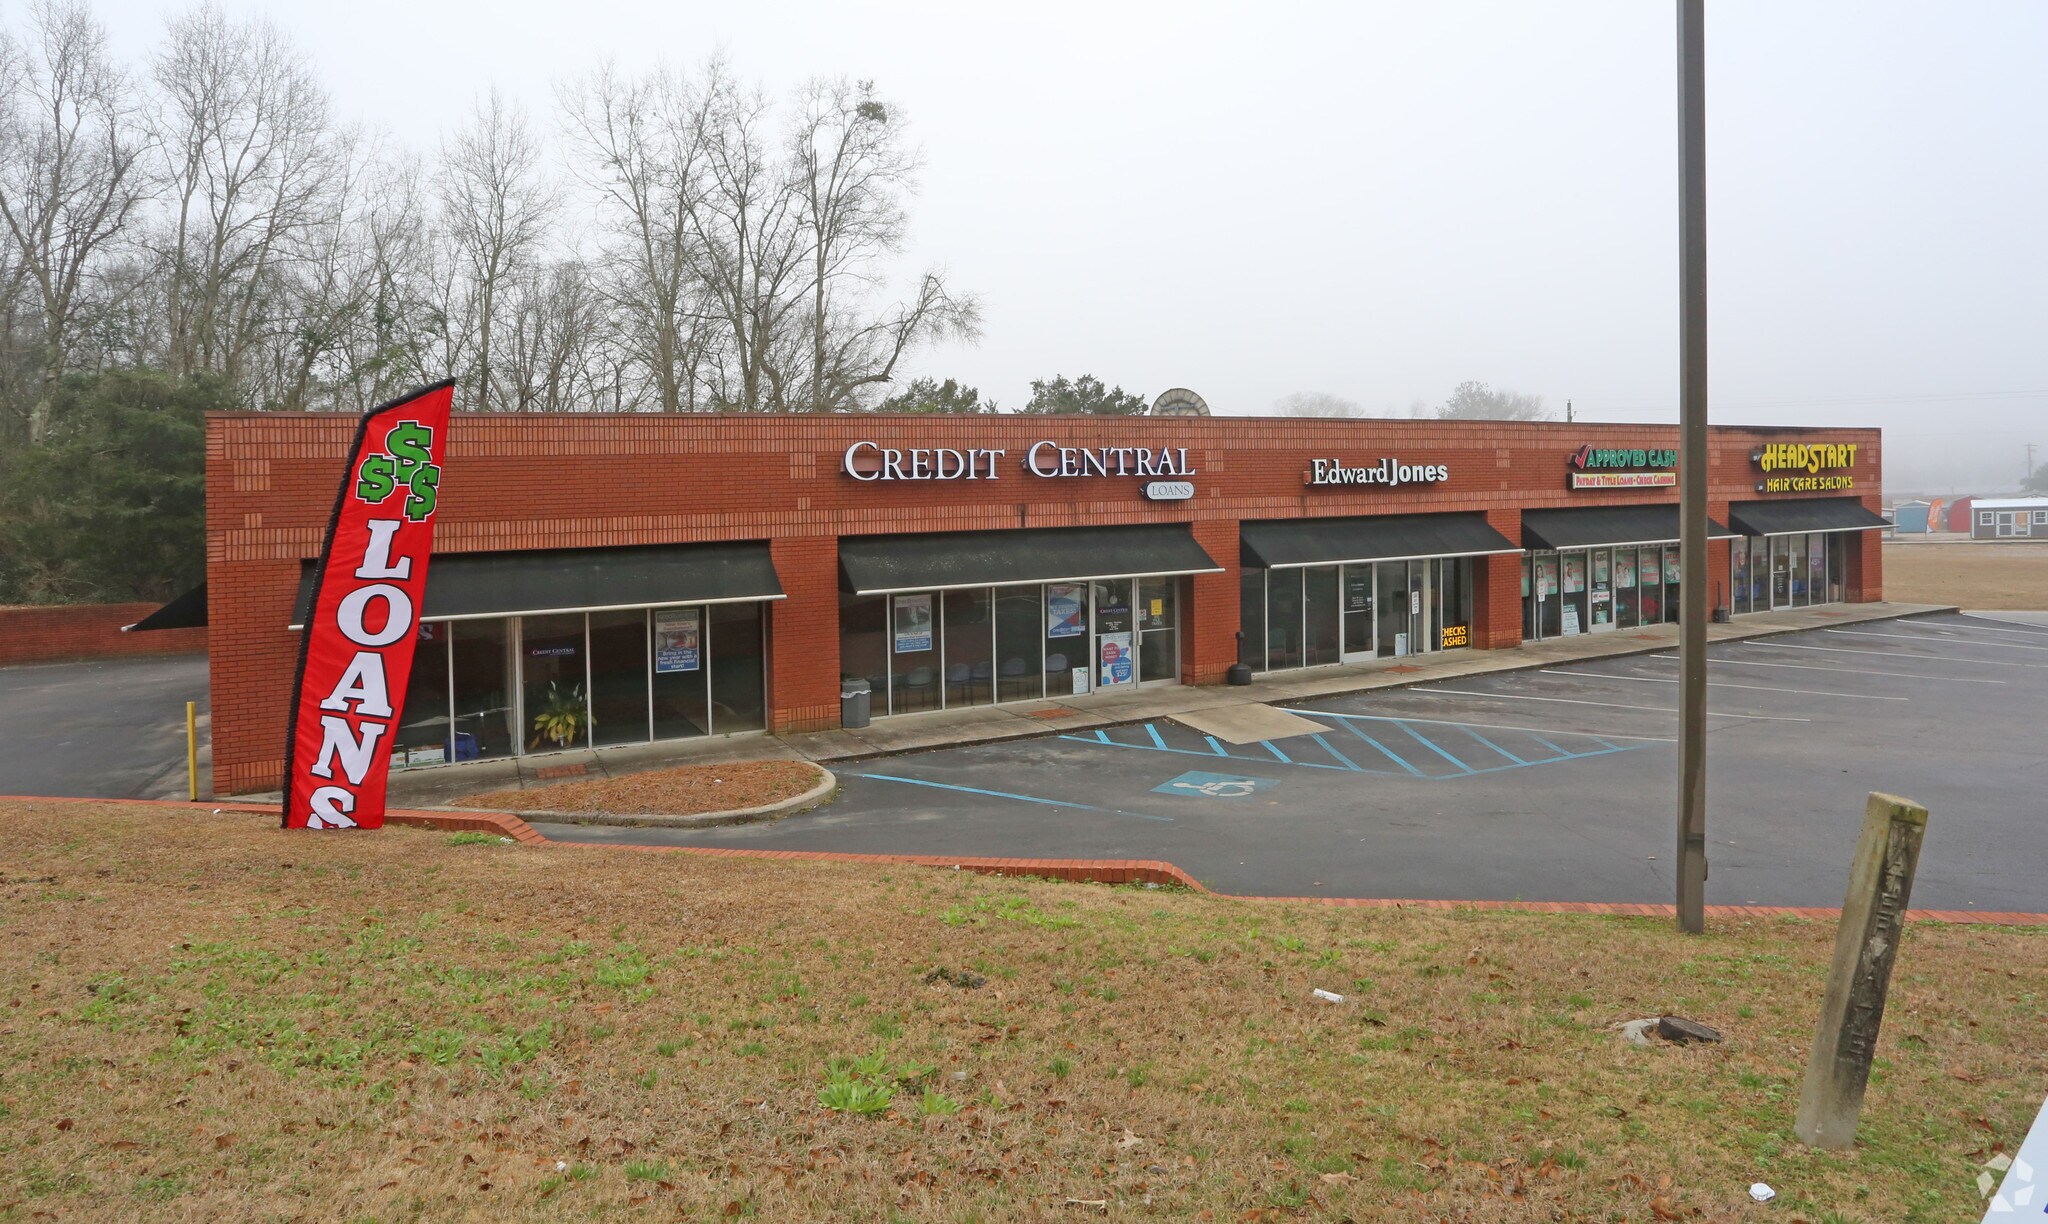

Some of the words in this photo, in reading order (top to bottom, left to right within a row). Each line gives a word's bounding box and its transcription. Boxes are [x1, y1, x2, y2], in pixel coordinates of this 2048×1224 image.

[845, 441, 1005, 481] CREDIT
[1027, 440, 1196, 478] CENTRAL
[1586, 449, 1647, 468] APPROVED
[1648, 449, 1678, 467] CASH
[1312, 458, 1389, 484] Edward
[1390, 458, 1449, 486] Jones
[1575, 476, 1596, 486] PAYDAY
[1602, 475, 1617, 486] TITLE
[1636, 475, 1653, 484] CHECK
[1653, 475, 1675, 484] CASHING
[1151, 485, 1190, 496] LOANS
[1766, 478, 1790, 492] HAIR
[1792, 477, 1818, 491] CARE
[1819, 476, 1854, 490] SALONS
[306, 518, 414, 830] LOANS
